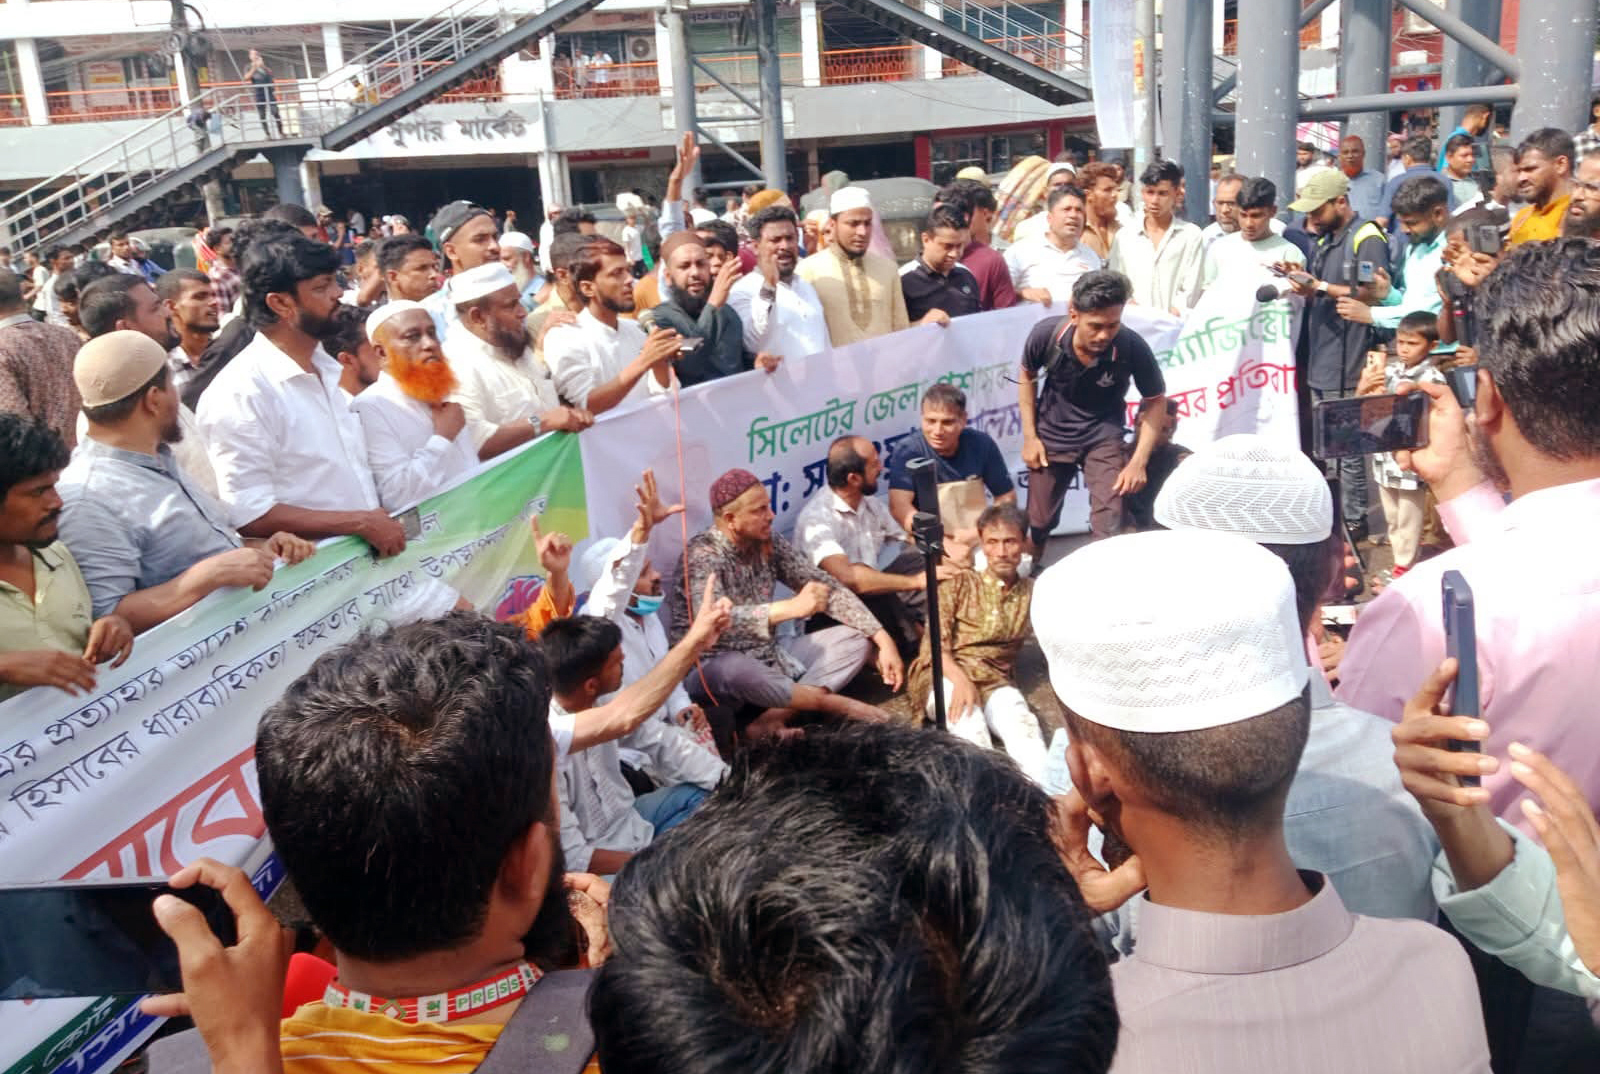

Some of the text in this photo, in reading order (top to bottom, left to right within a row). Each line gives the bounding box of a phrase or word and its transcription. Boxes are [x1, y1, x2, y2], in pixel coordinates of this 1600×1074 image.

[456, 110, 527, 141] মার্কেট
[1217, 358, 1296, 410] প্রতিবা
[747, 397, 857, 463] সিলেটের
[864, 380, 928, 425] জেল
[8, 730, 142, 822] হিসাবের
[142, 638, 288, 739] ধারাবাহিকতা
[457, 978, 520, 1009] PRESS
